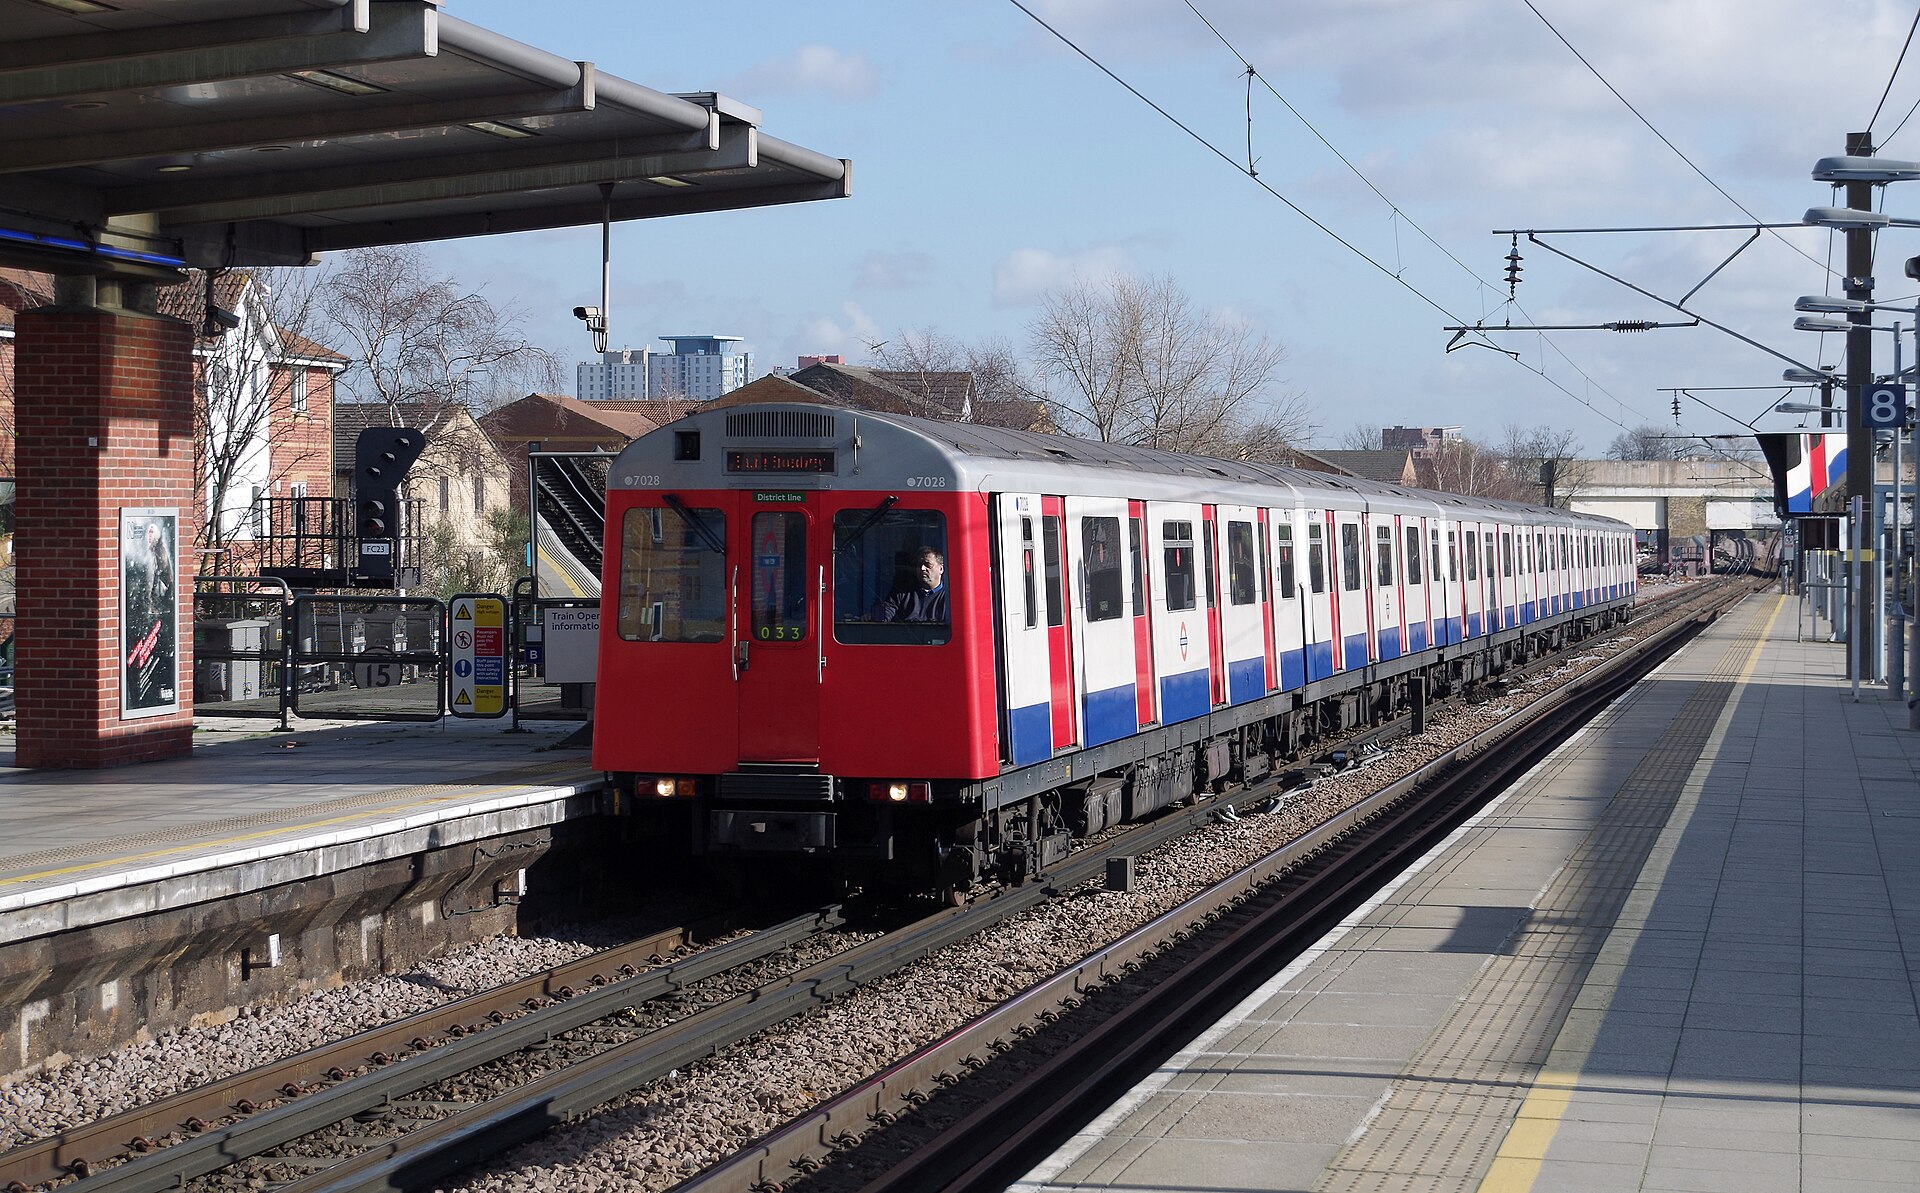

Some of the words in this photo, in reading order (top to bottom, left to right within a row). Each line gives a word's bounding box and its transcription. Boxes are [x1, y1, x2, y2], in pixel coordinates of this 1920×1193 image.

[1870, 389, 1897, 423] 8
[633, 475, 660, 486] 7028
[916, 476, 946, 488] 7028
[757, 493, 786, 501] District
[787, 493, 802, 502] line
[366, 545, 385, 553] FC23
[552, 612, 574, 620] Train
[552, 623, 600, 631] informatio
[529, 650, 538, 660] B
[366, 664, 391, 688] 15
